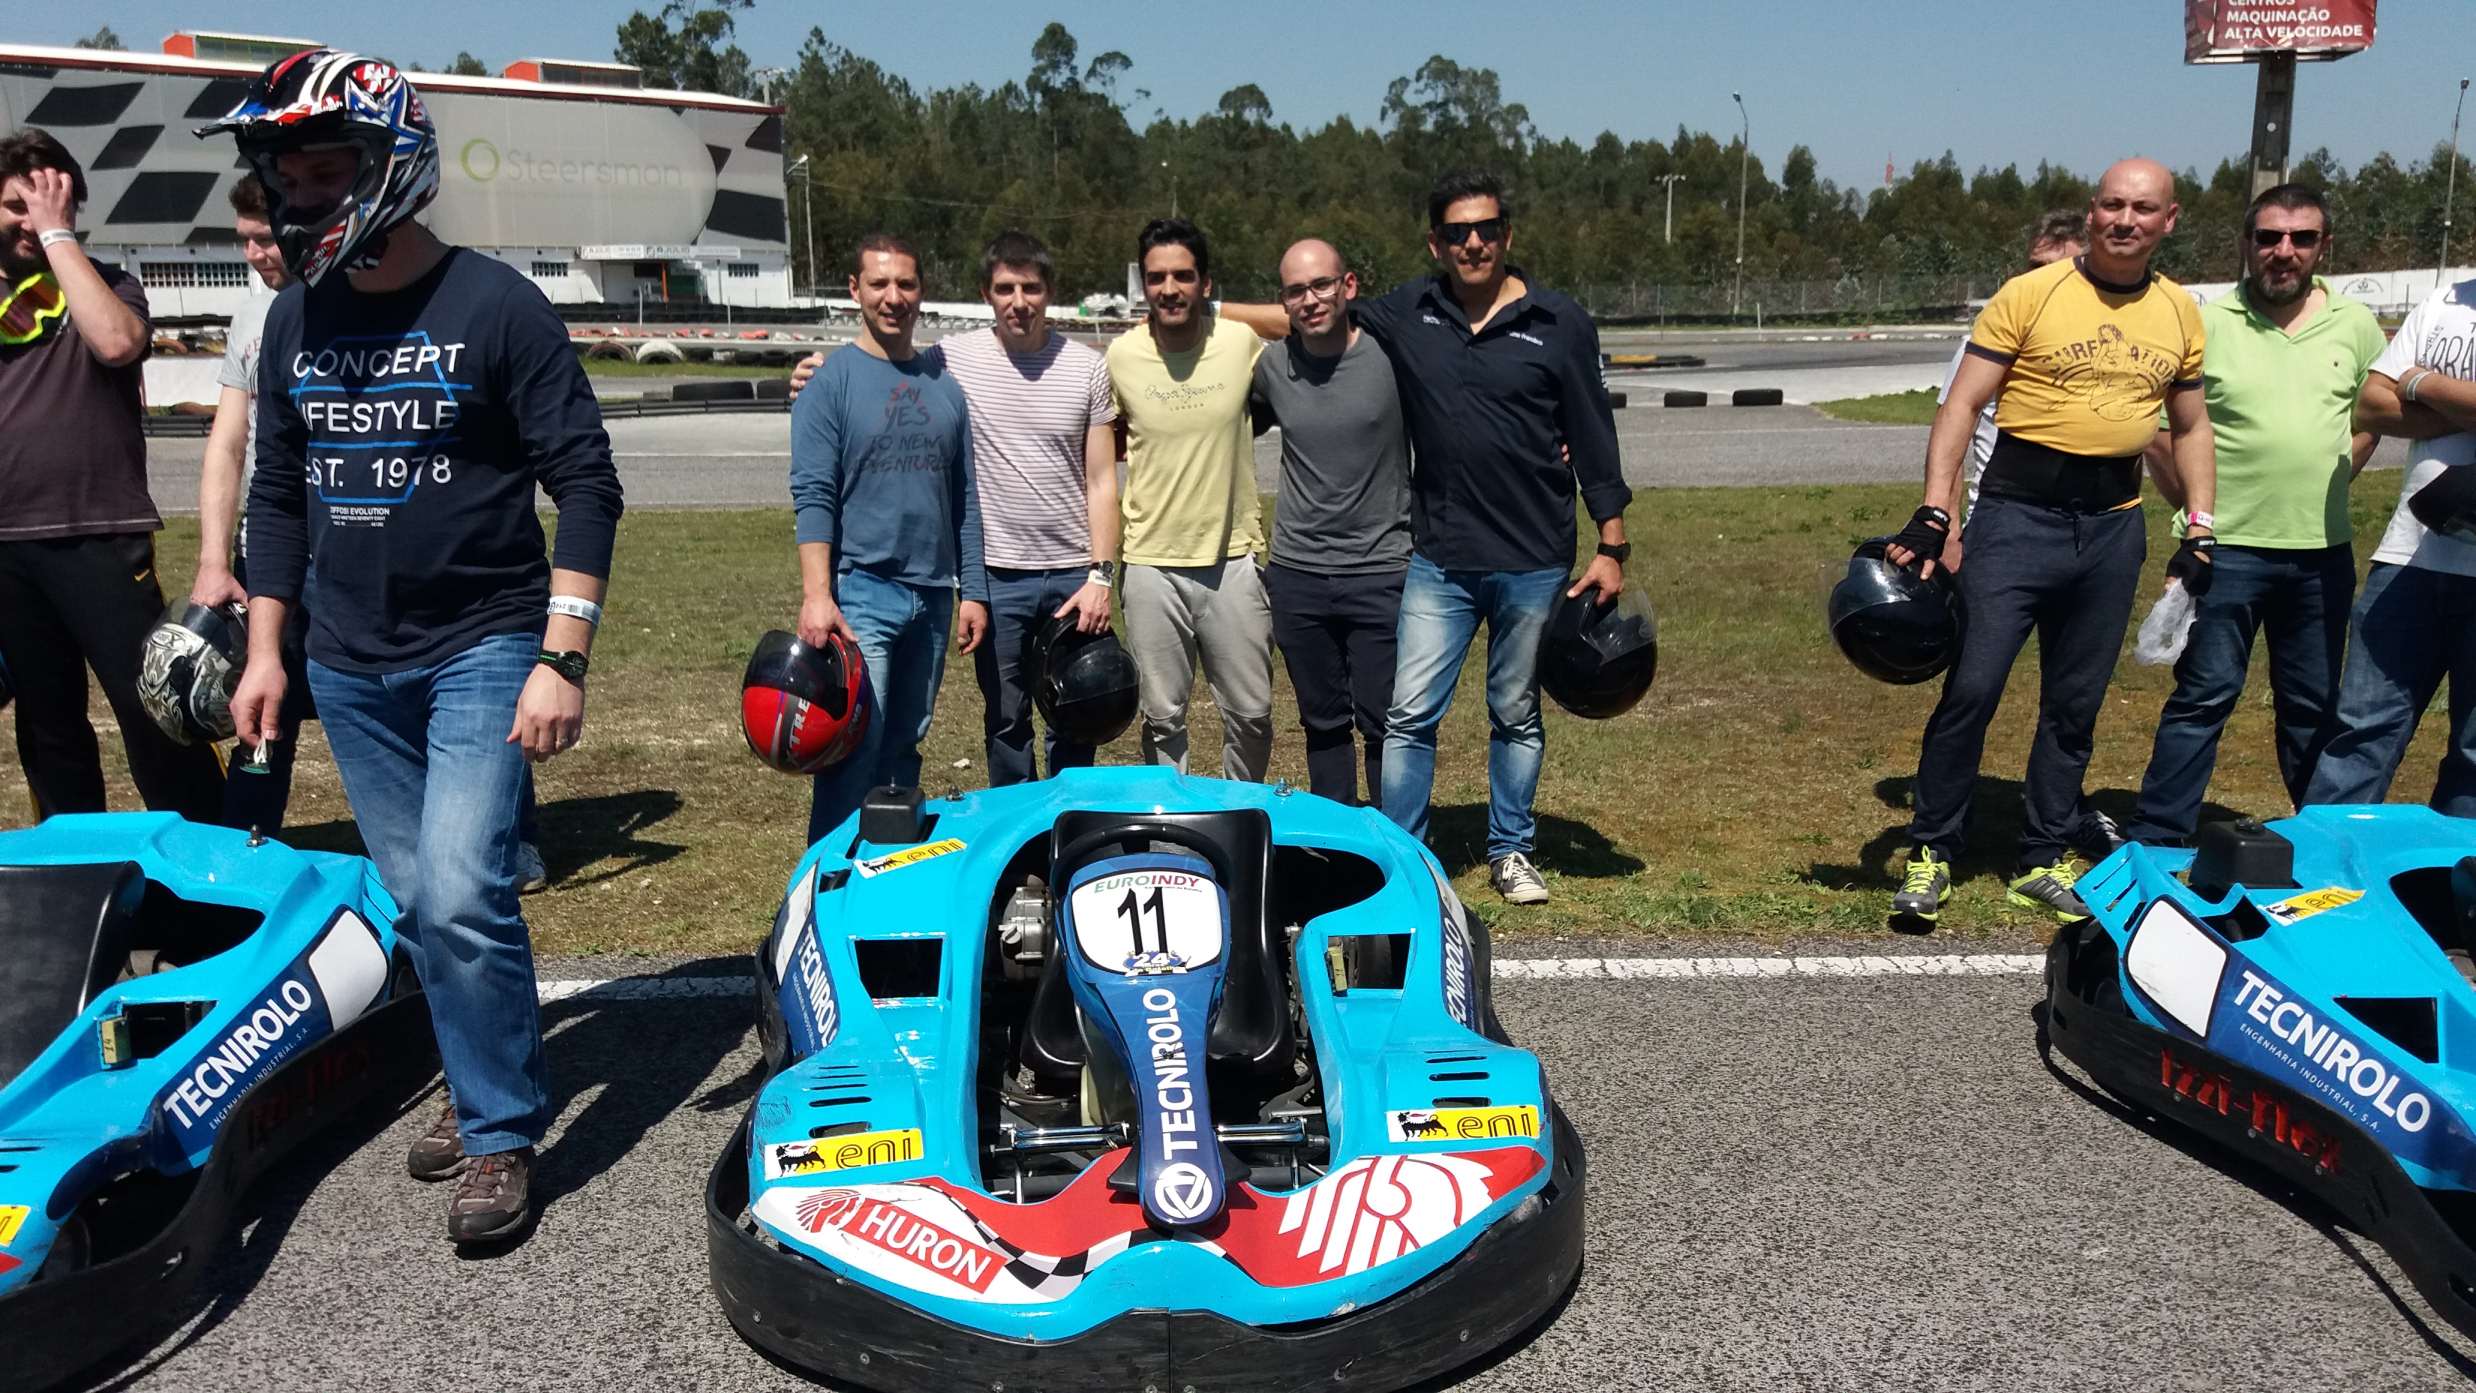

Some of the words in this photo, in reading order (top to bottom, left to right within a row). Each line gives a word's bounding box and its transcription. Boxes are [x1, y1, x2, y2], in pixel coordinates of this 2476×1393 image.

[2224, 27, 2262, 39] ALTA
[2266, 25, 2363, 38] VELOCIDADE
[2226, 7, 2330, 24] MAQUINAÇÃO
[507, 149, 682, 186] Steersman
[293, 342, 466, 378] CONCEPT
[884, 404, 931, 433] YES
[898, 432, 943, 452] NEW
[371, 453, 452, 488] 1978
[1094, 874, 1200, 893] EUROINDY
[1117, 886, 1169, 956] 11
[797, 923, 839, 1048] TECNIROL
[163, 979, 312, 1130] TECNIROLO
[2233, 969, 2431, 1133] TECNIROLO
[1142, 988, 1199, 1161] TECNIROLO
[2239, 1022, 2299, 1071] ENGENHARIA
[2298, 1066, 2358, 1119] INDUSTRIAL,
[2359, 1113, 2382, 1134] S.A.
[1456, 1105, 1532, 1139] eni
[835, 1128, 912, 1170] eni
[858, 1203, 992, 1285] HURON
